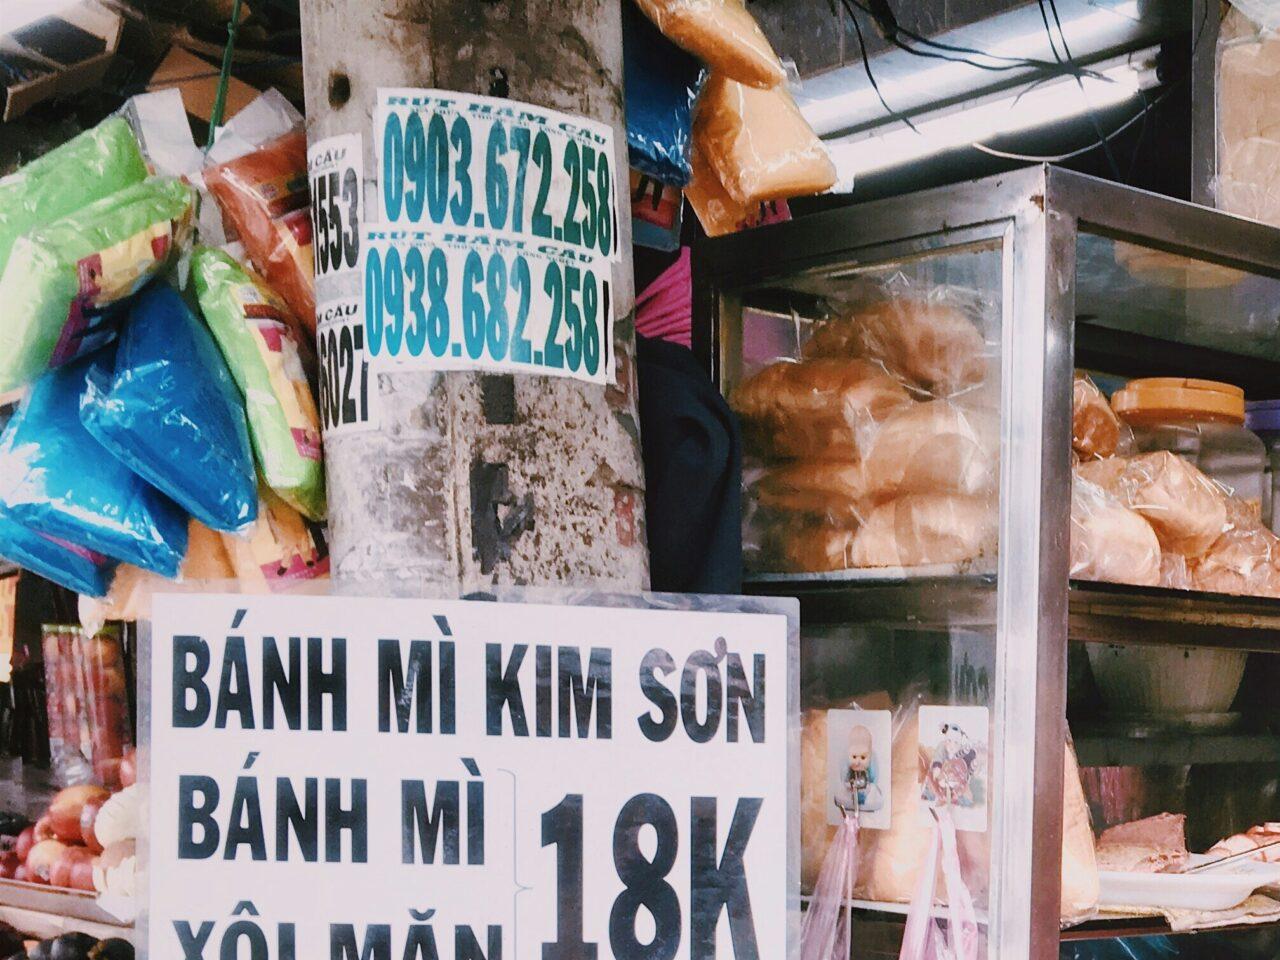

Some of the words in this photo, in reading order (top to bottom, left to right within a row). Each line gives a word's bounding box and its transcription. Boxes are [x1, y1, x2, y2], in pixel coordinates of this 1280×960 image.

[383, 111, 611, 257] 0903.672.258
[365, 246, 600, 376] 0938.682.258
[170, 609, 348, 732] BÁNH
[377, 614, 456, 735] MÌ
[485, 643, 613, 740] KIM
[636, 636, 766, 744] SƠN
[177, 751, 368, 863] BÁNH
[401, 757, 485, 865] MÌ
